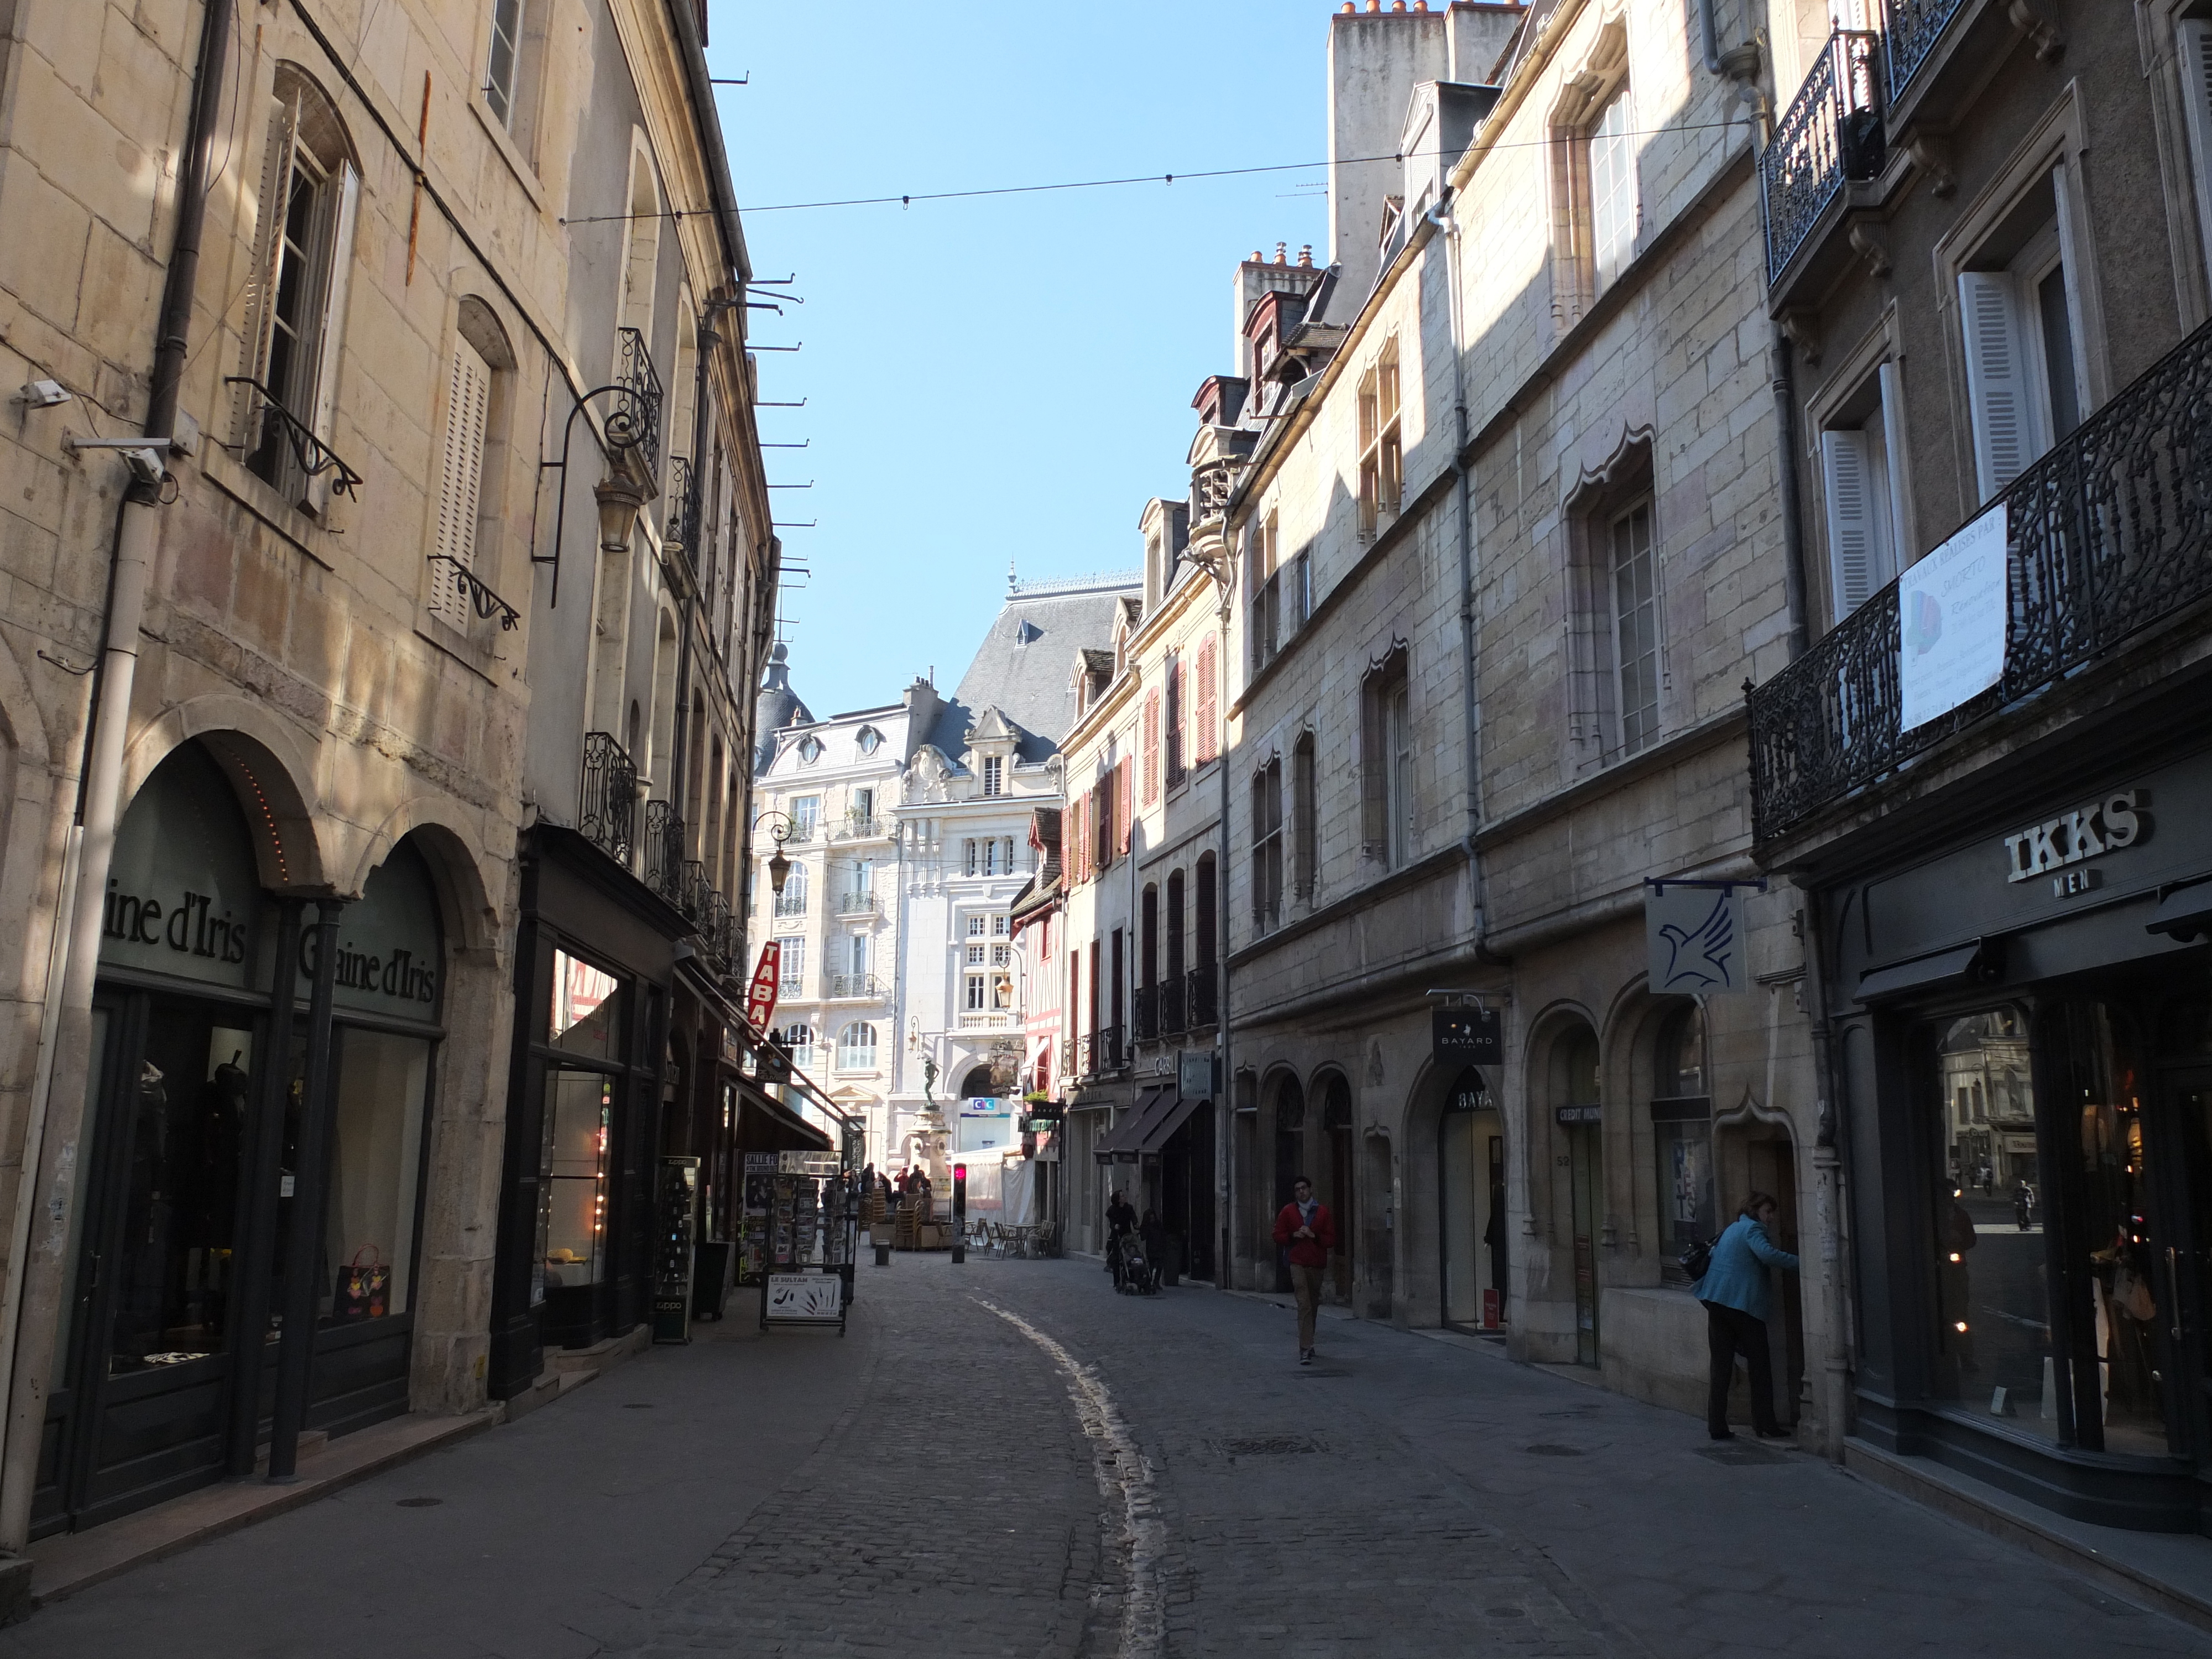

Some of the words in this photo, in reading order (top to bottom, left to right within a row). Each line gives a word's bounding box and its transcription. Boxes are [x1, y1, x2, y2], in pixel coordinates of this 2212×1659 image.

[1903, 555, 1937, 592] TRAVAUX
[1978, 515, 1994, 540] PAR
[1941, 554, 1985, 599] SMORTO
[2004, 790, 2138, 883] IKKS
[2053, 869, 2088, 898] MEN
[104, 879, 162, 945] ine
[299, 924, 380, 992] Gaine
[748, 945, 777, 1040] TABAC
[1155, 1056, 1177, 1076] CARBILL
[1459, 1091, 1493, 1109] BAYA
[1560, 1108, 1581, 1120] CREDIT
[1584, 1107, 1601, 1119] MUN
[747, 1155, 768, 1165] SALLIE
[1557, 1156, 1569, 1166] 52
